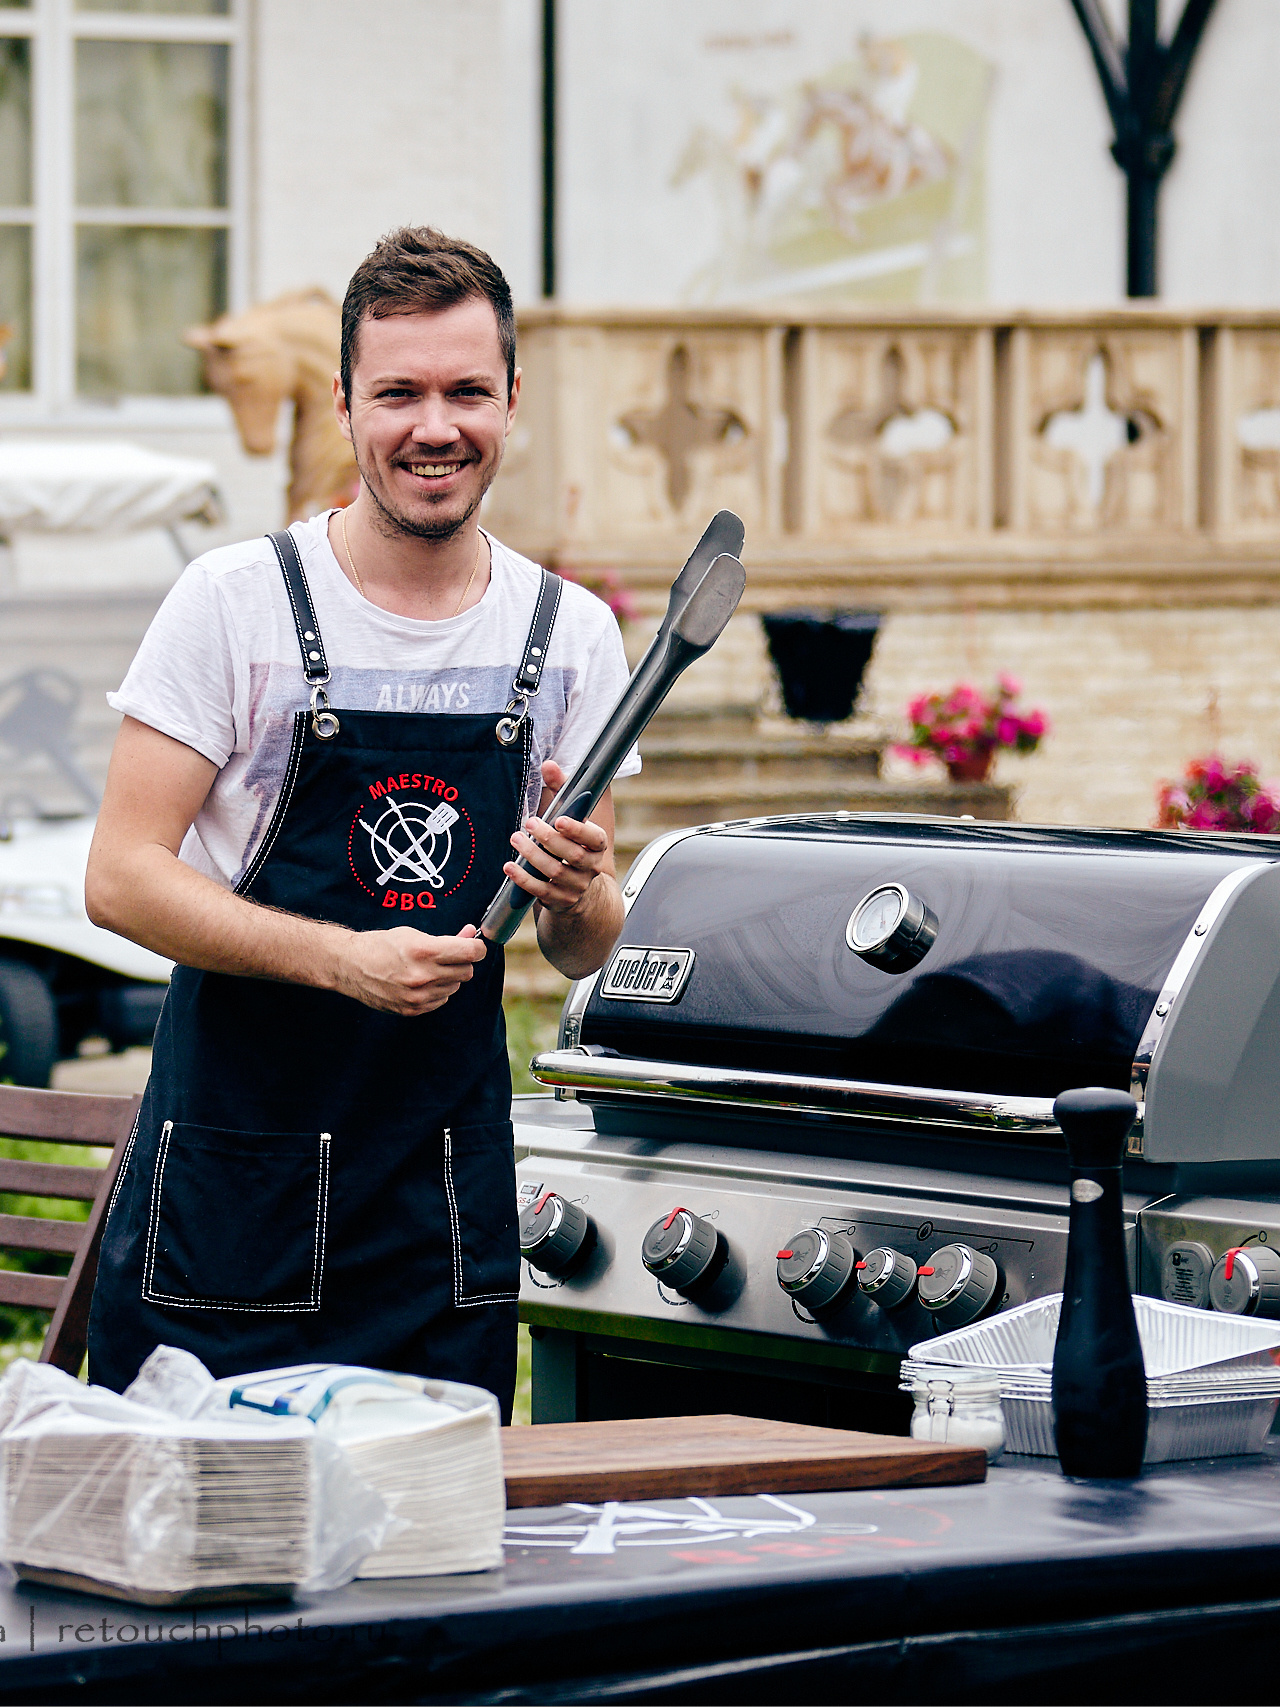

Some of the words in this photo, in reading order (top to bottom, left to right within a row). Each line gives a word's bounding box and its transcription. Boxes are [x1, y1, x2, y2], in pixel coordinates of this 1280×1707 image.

[375, 681, 471, 712] ALWAYS
[368, 773, 460, 803] MAESTRO
[381, 889, 437, 911] BBQ
